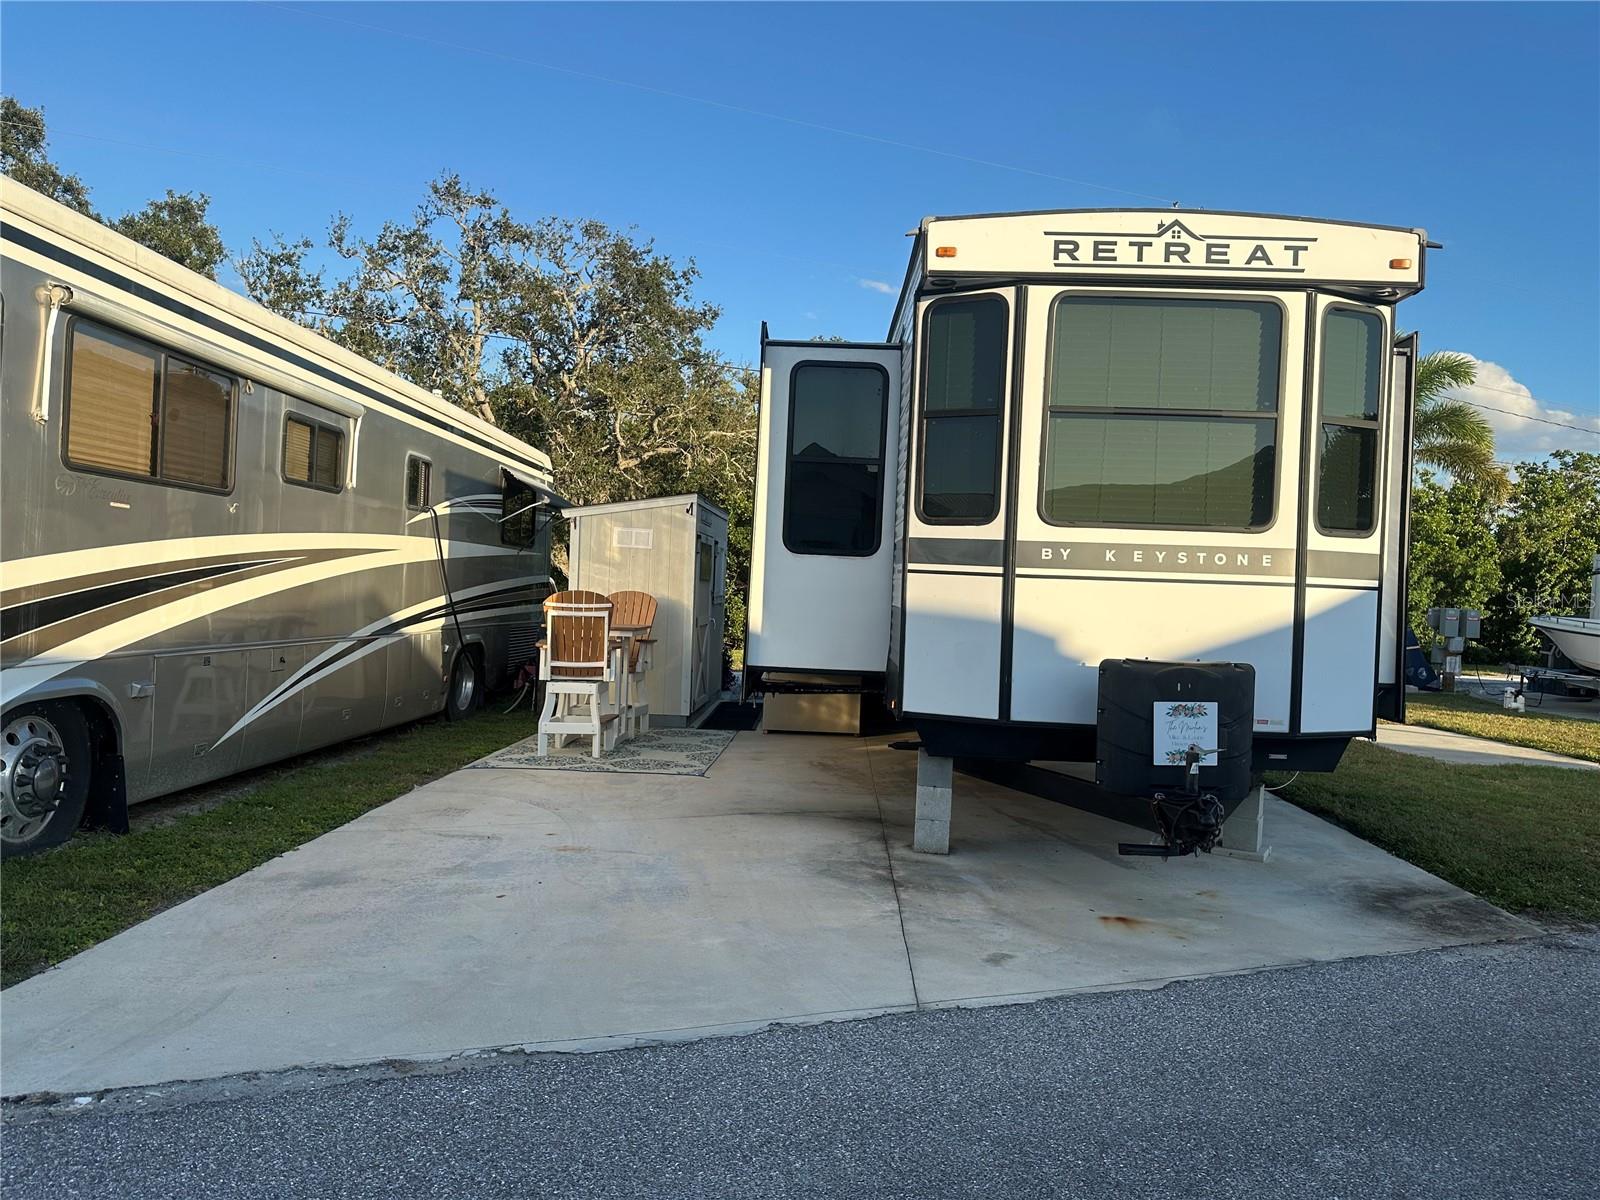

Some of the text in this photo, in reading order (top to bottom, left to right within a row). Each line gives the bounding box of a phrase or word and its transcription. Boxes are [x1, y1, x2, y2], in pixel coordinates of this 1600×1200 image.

[1053, 239, 1309, 267] RETREAT
[1041, 548, 1272, 567] BY KEYSTONE
